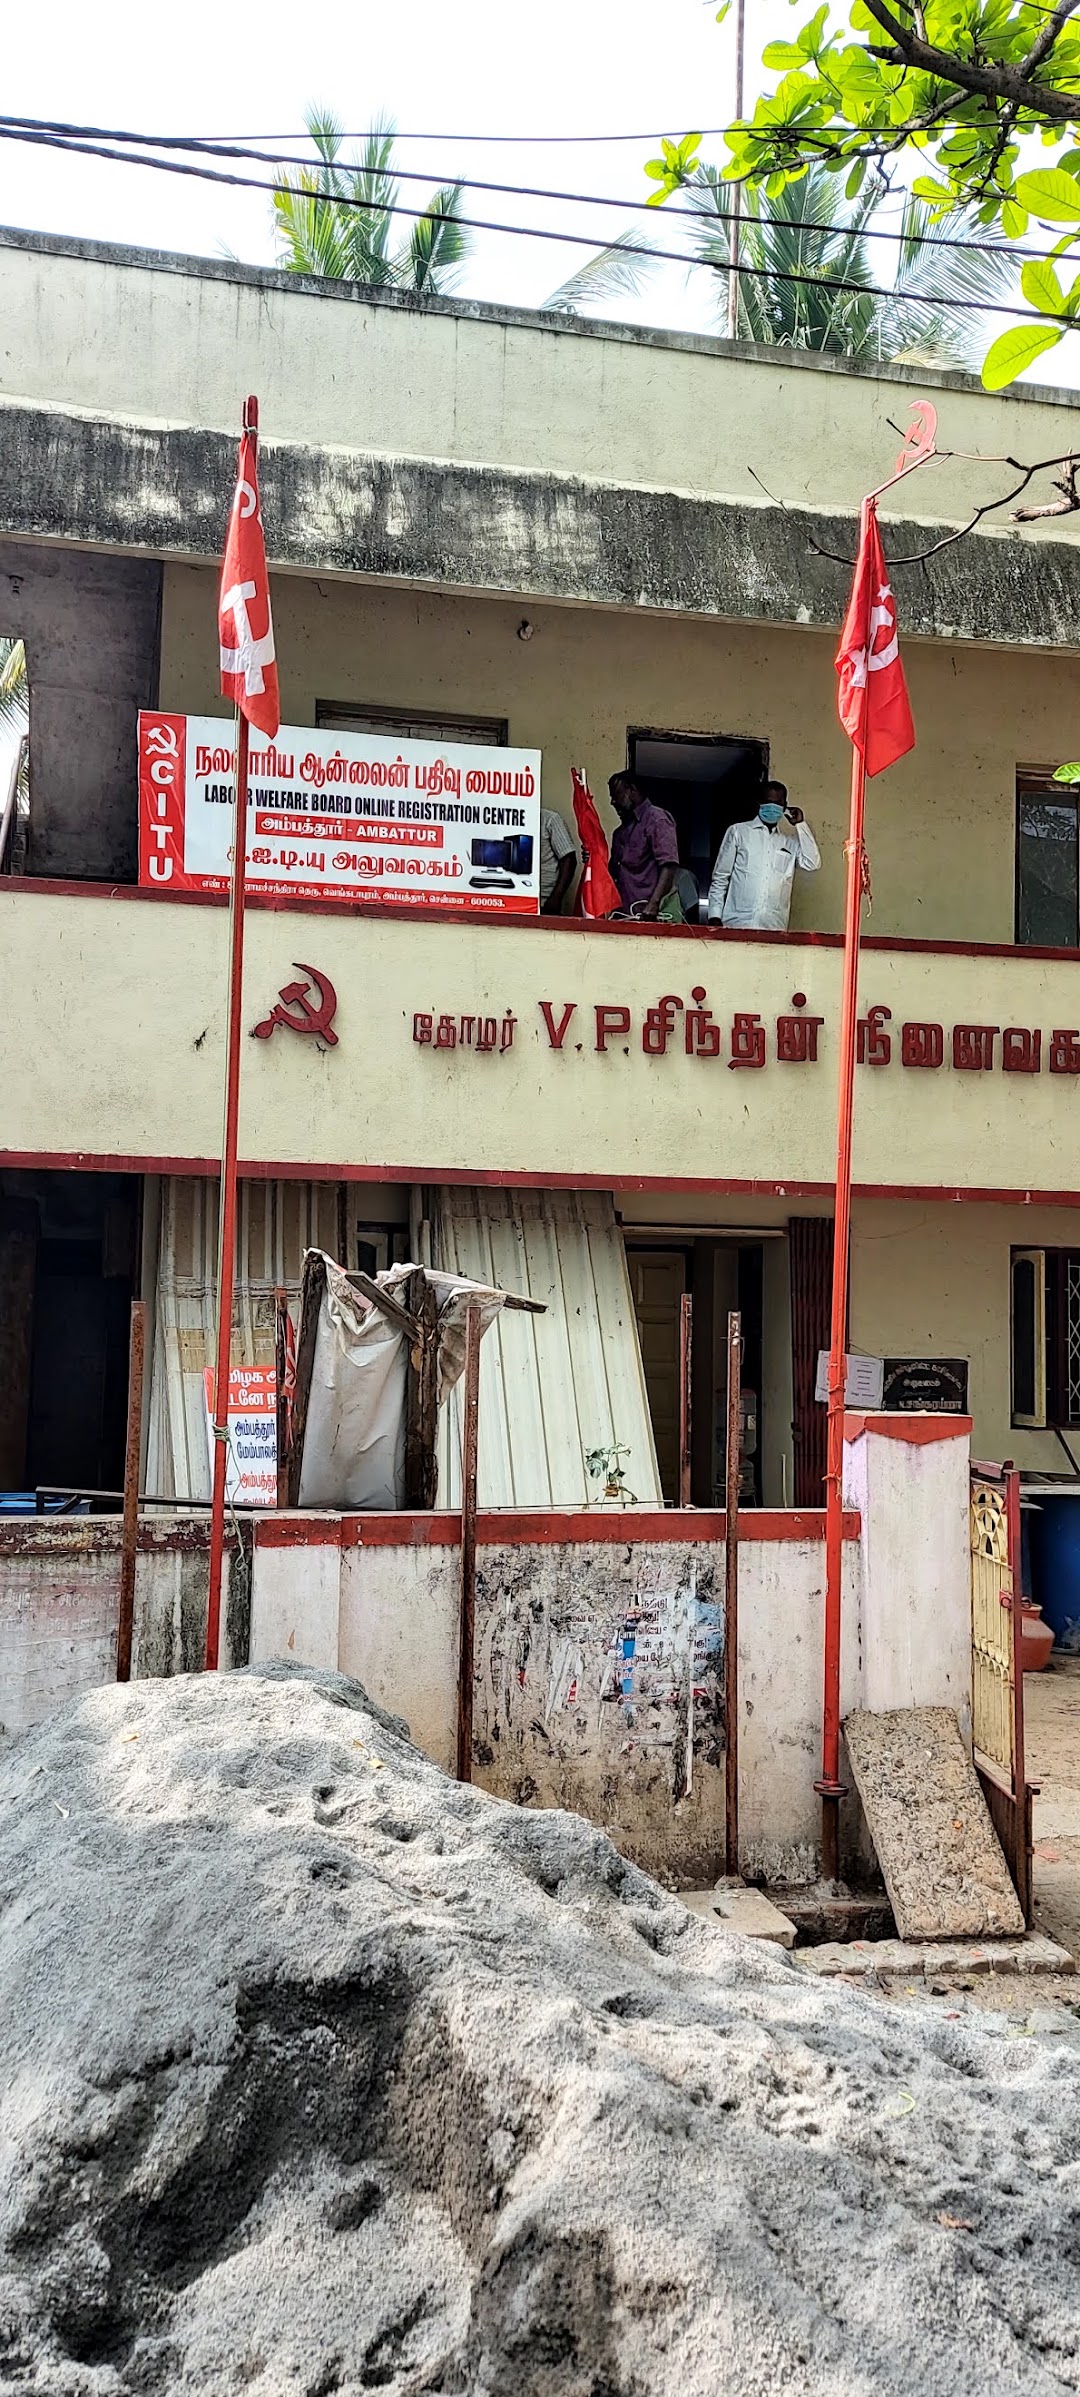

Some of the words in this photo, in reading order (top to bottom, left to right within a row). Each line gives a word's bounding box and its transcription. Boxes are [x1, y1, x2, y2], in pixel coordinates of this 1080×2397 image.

[299, 750, 411, 788] ஆன்லைன்
[415, 759, 461, 800] பதிவு
[466, 766, 535, 797] மையம்
[205, 784, 253, 807] LABOR
[256, 788, 308, 811] WELFARE
[312, 793, 351, 814] BOARD
[355, 797, 395, 818] ONLINE
[398, 800, 480, 824] REGISTRATION
[483, 807, 525, 827] CENTRE
[149, 760, 174, 882] CITU
[260, 816, 344, 837] அம்பத்தூர்
[356, 825, 437, 842] AMBATTUR
[332, 851, 463, 879] அலுவலகம்
[413, 1008, 517, 1052] தோழர்
[229, 1369, 263, 1388] மிழக
[228, 1389, 263, 1406] டனே
[235, 1418, 275, 1441] அம்பத்தூர்
[237, 1441, 277, 1464] மேம்பாலத்
[240, 1470, 277, 1493] அம்பத்தூ
